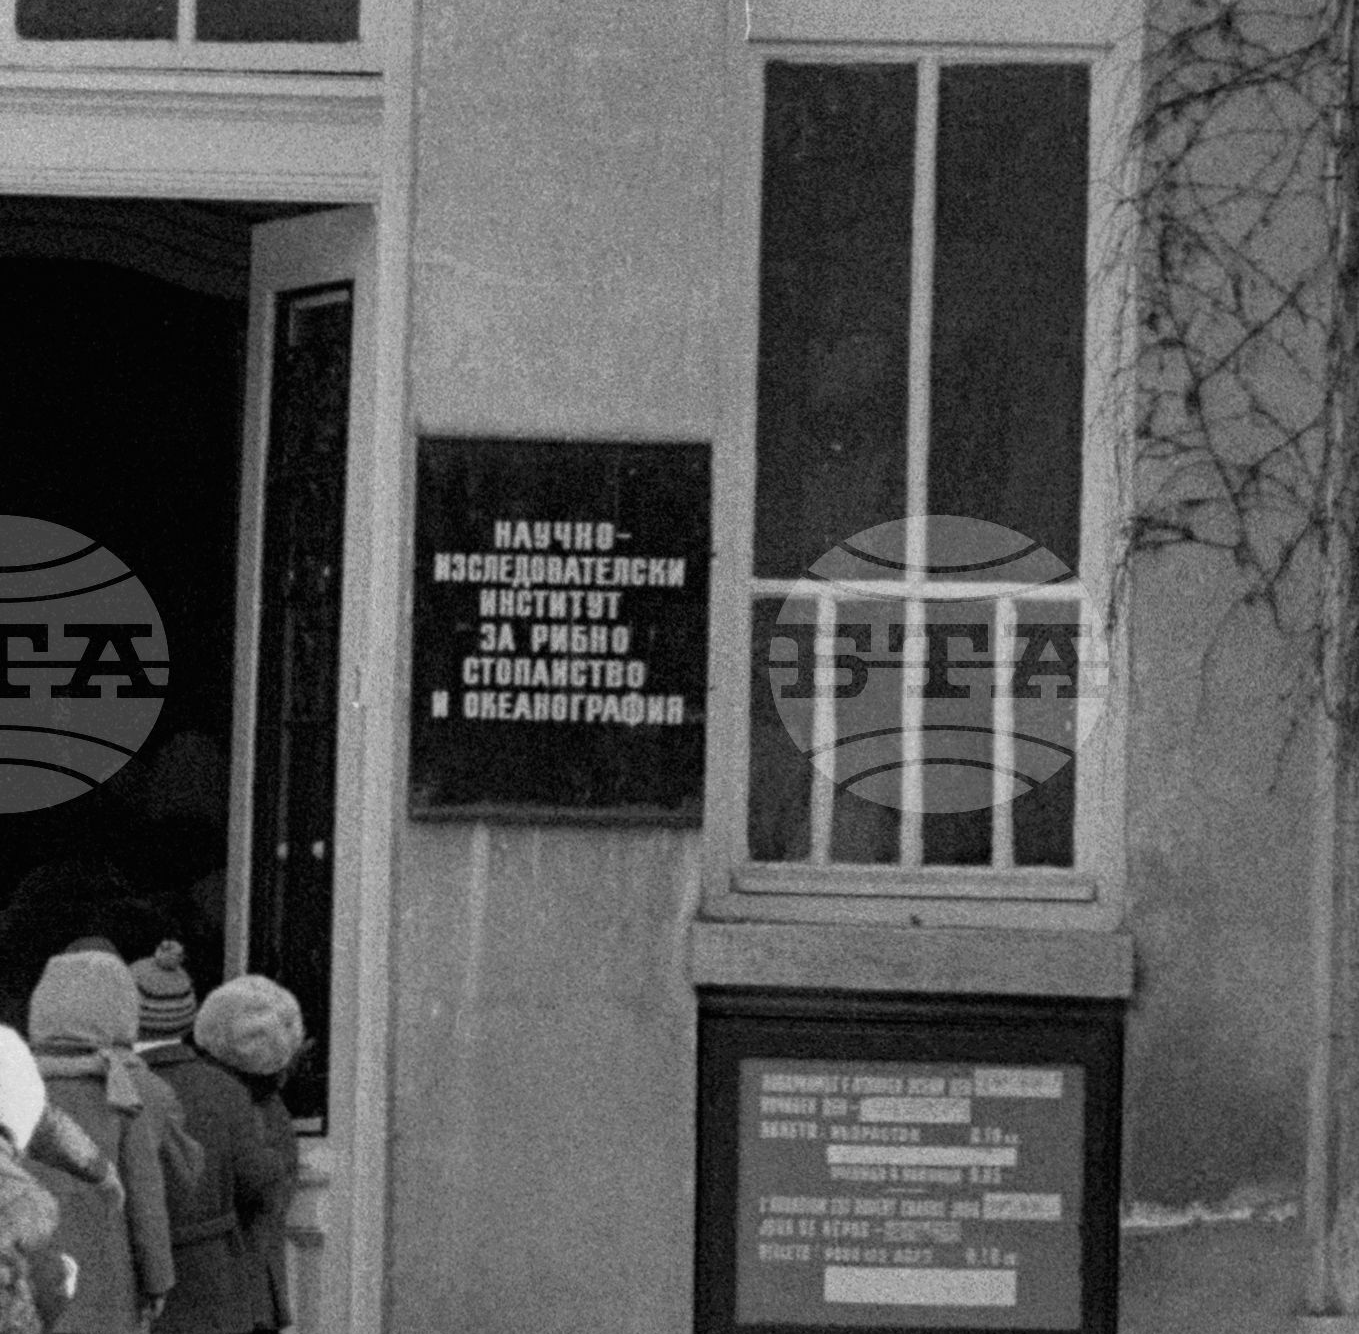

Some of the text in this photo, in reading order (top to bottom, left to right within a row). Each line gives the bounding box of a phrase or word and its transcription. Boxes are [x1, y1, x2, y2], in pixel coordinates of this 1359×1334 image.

[494, 520, 632, 550] НАУЧНО-
[433, 552, 686, 588] ИЗСЛЕДОВАТЕЛСКИ
[479, 589, 622, 620] ИНСТИТУТ
[479, 622, 631, 654] ЗА РИБНО
[462, 657, 648, 688] СТОПАНСТВО
[431, 690, 685, 727] И ОКЕАНОГРАФИЯ
